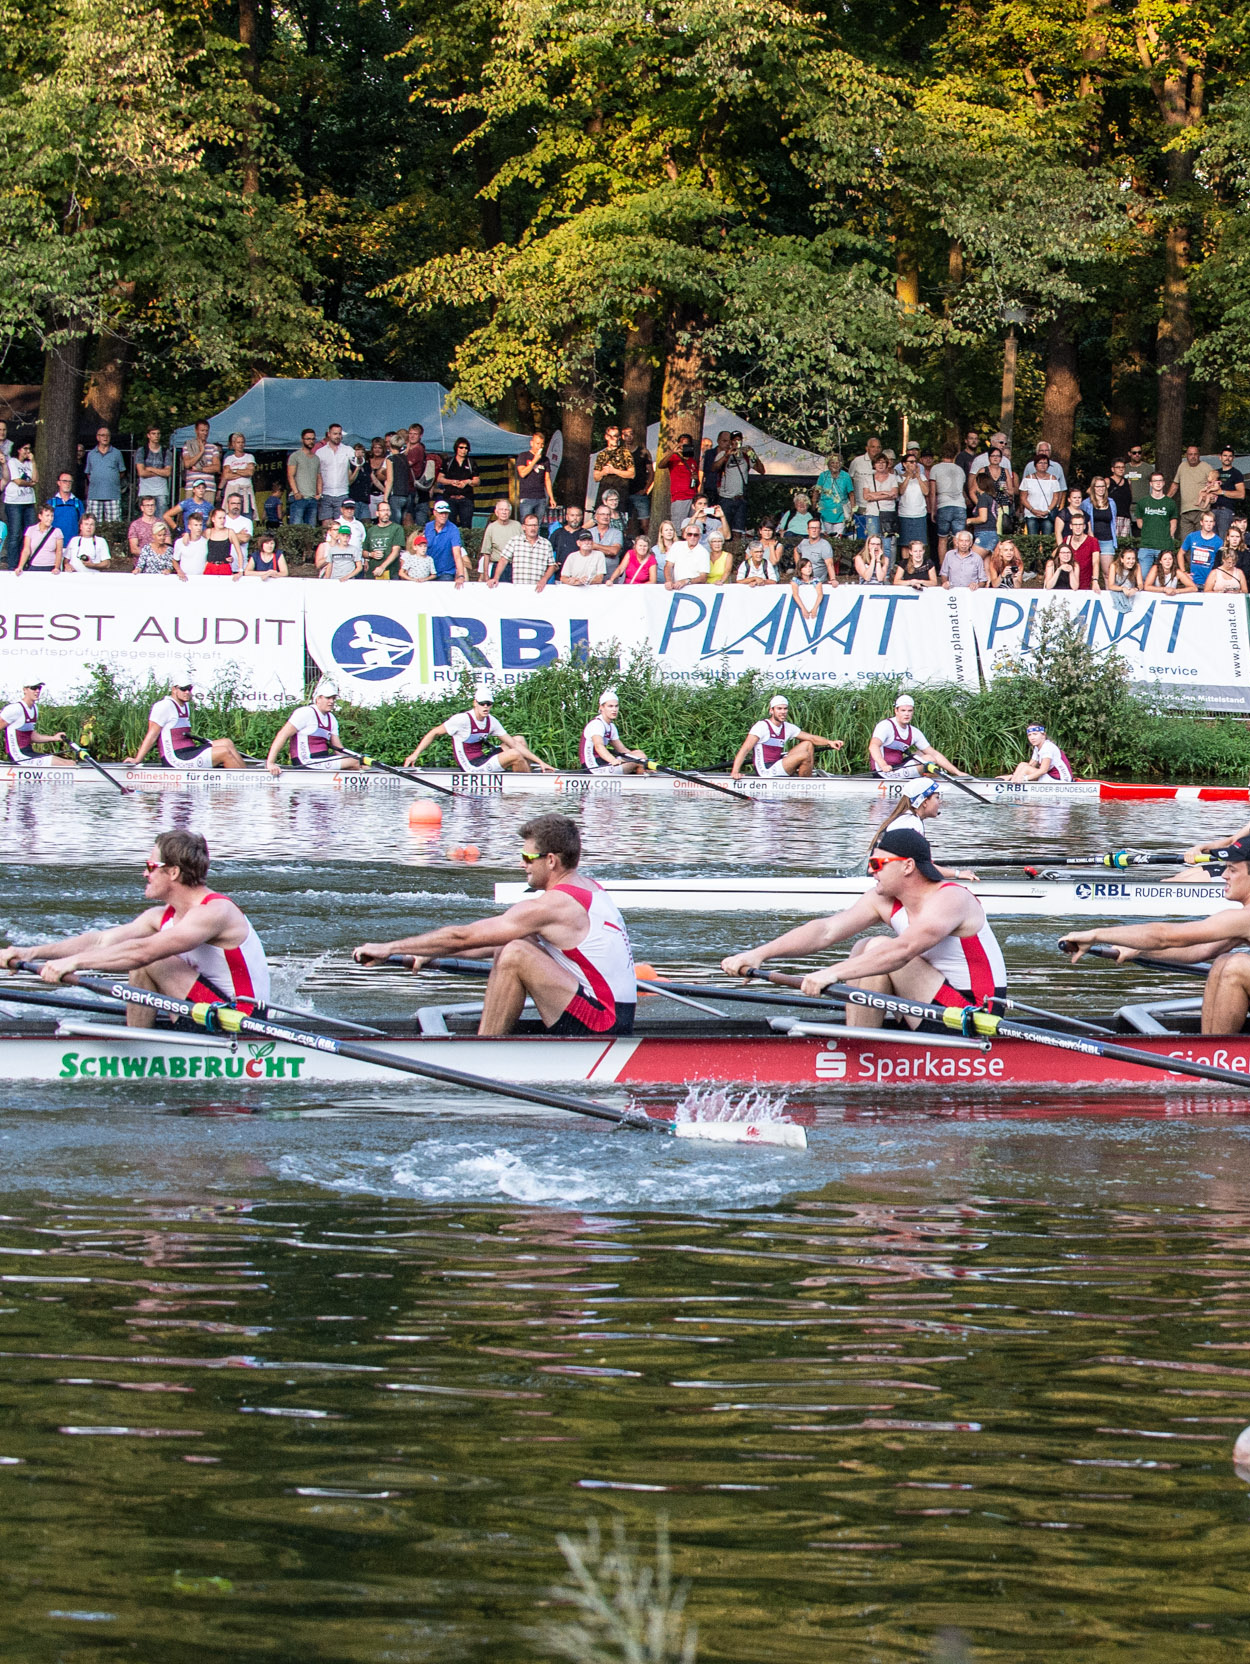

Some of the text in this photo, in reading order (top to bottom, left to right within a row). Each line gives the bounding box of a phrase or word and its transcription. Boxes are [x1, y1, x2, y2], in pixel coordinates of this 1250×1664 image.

[133, 616, 296, 646] AUDIT
[659, 592, 919, 661] PLANAT
[431, 615, 621, 669] RBL
[948, 595, 965, 682] www.planat.de
[1227, 602, 1242, 678] www.planat.de
[661, 669, 913, 682] consulting software service
[1148, 665, 1198, 676] service
[1198, 694, 1246, 704] Mittelstand
[7, 768, 280, 783] 4row.com Onlineshop für den Rudersport
[333, 772, 502, 786] 4row.com BERLIN
[554, 776, 622, 790] 4row.com
[733, 780, 747, 789] für
[750, 780, 767, 789] den
[773, 780, 826, 791] Rudersport
[1006, 783, 1097, 793] RBL RUDER-BUNDESLIGA
[1095, 883, 1131, 896] RBL
[1135, 887, 1226, 899] RUDER-BUNDESL
[111, 983, 190, 1016] Sparkasse
[848, 990, 937, 1019] Giessen
[317, 1037, 337, 1052] RBL
[1081, 1042, 1101, 1055] RBL
[59, 1051, 305, 1079] SCHWABFRUCHT
[859, 1051, 1004, 1081] Sparkasse
